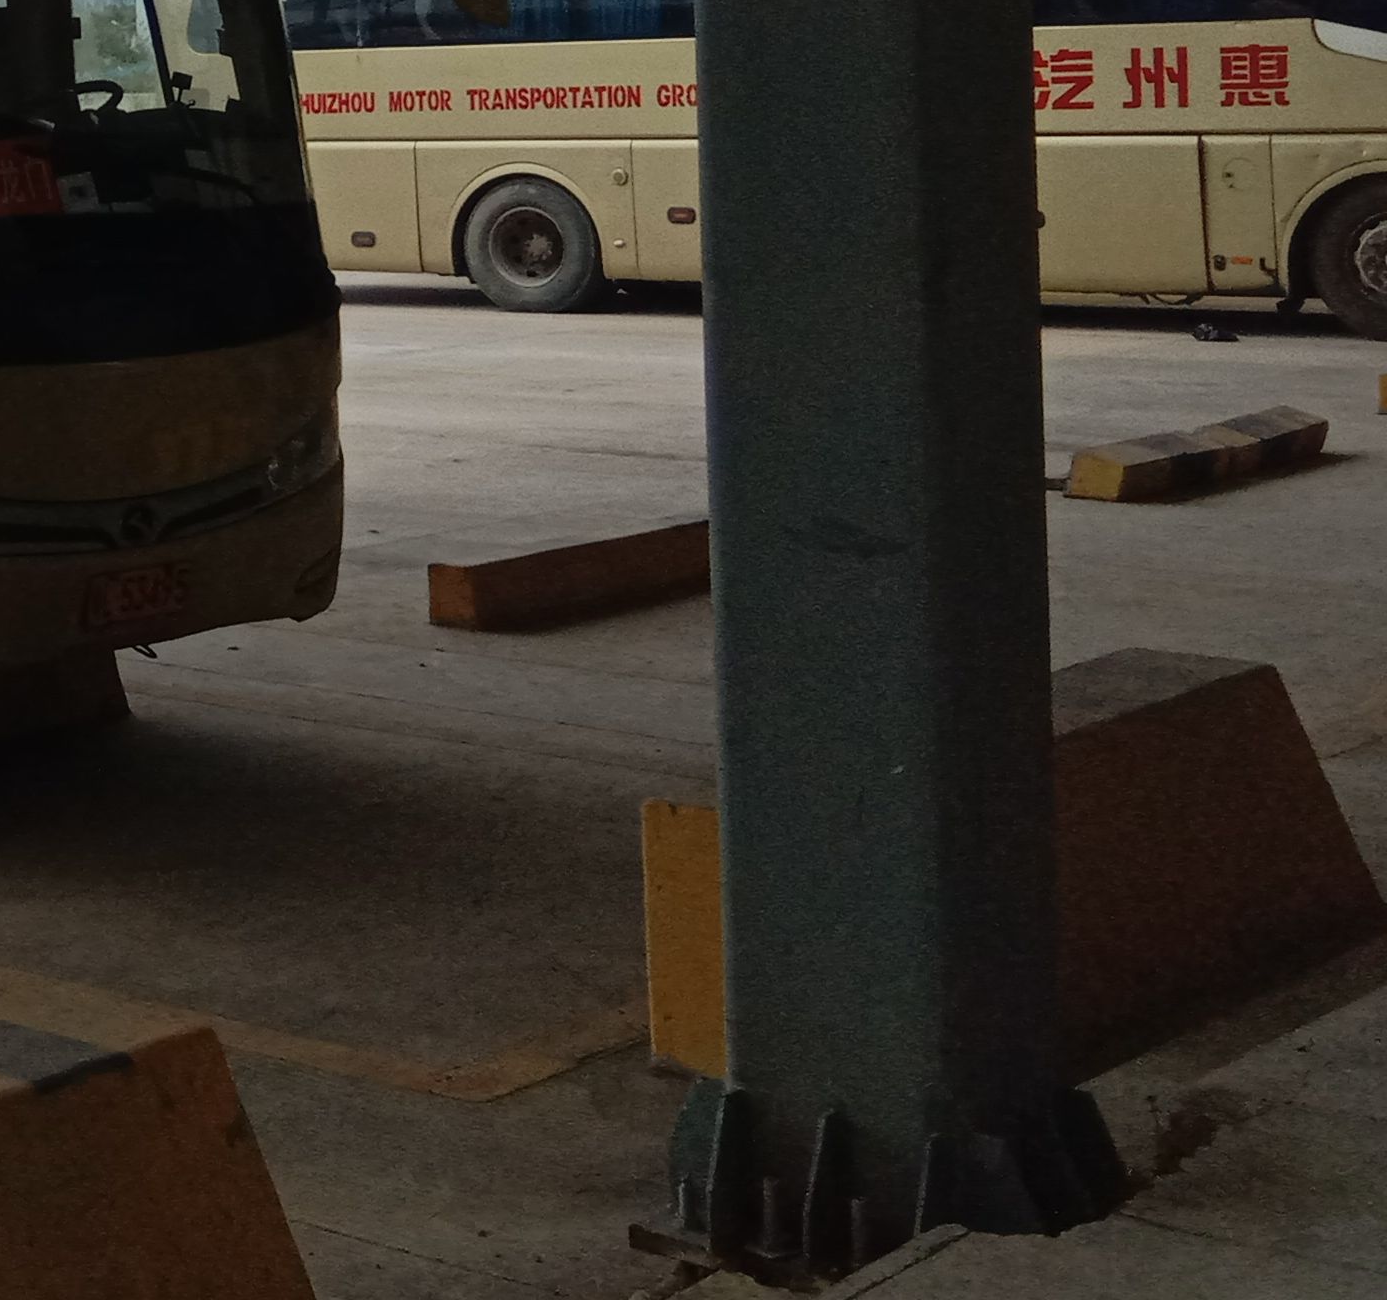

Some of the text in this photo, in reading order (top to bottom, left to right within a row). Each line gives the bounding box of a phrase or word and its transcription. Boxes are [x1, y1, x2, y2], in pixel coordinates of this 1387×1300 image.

[299, 92, 375, 114] HUIZHOU
[389, 89, 452, 113] MOTOR
[468, 85, 642, 111] TRANSPORTATION
